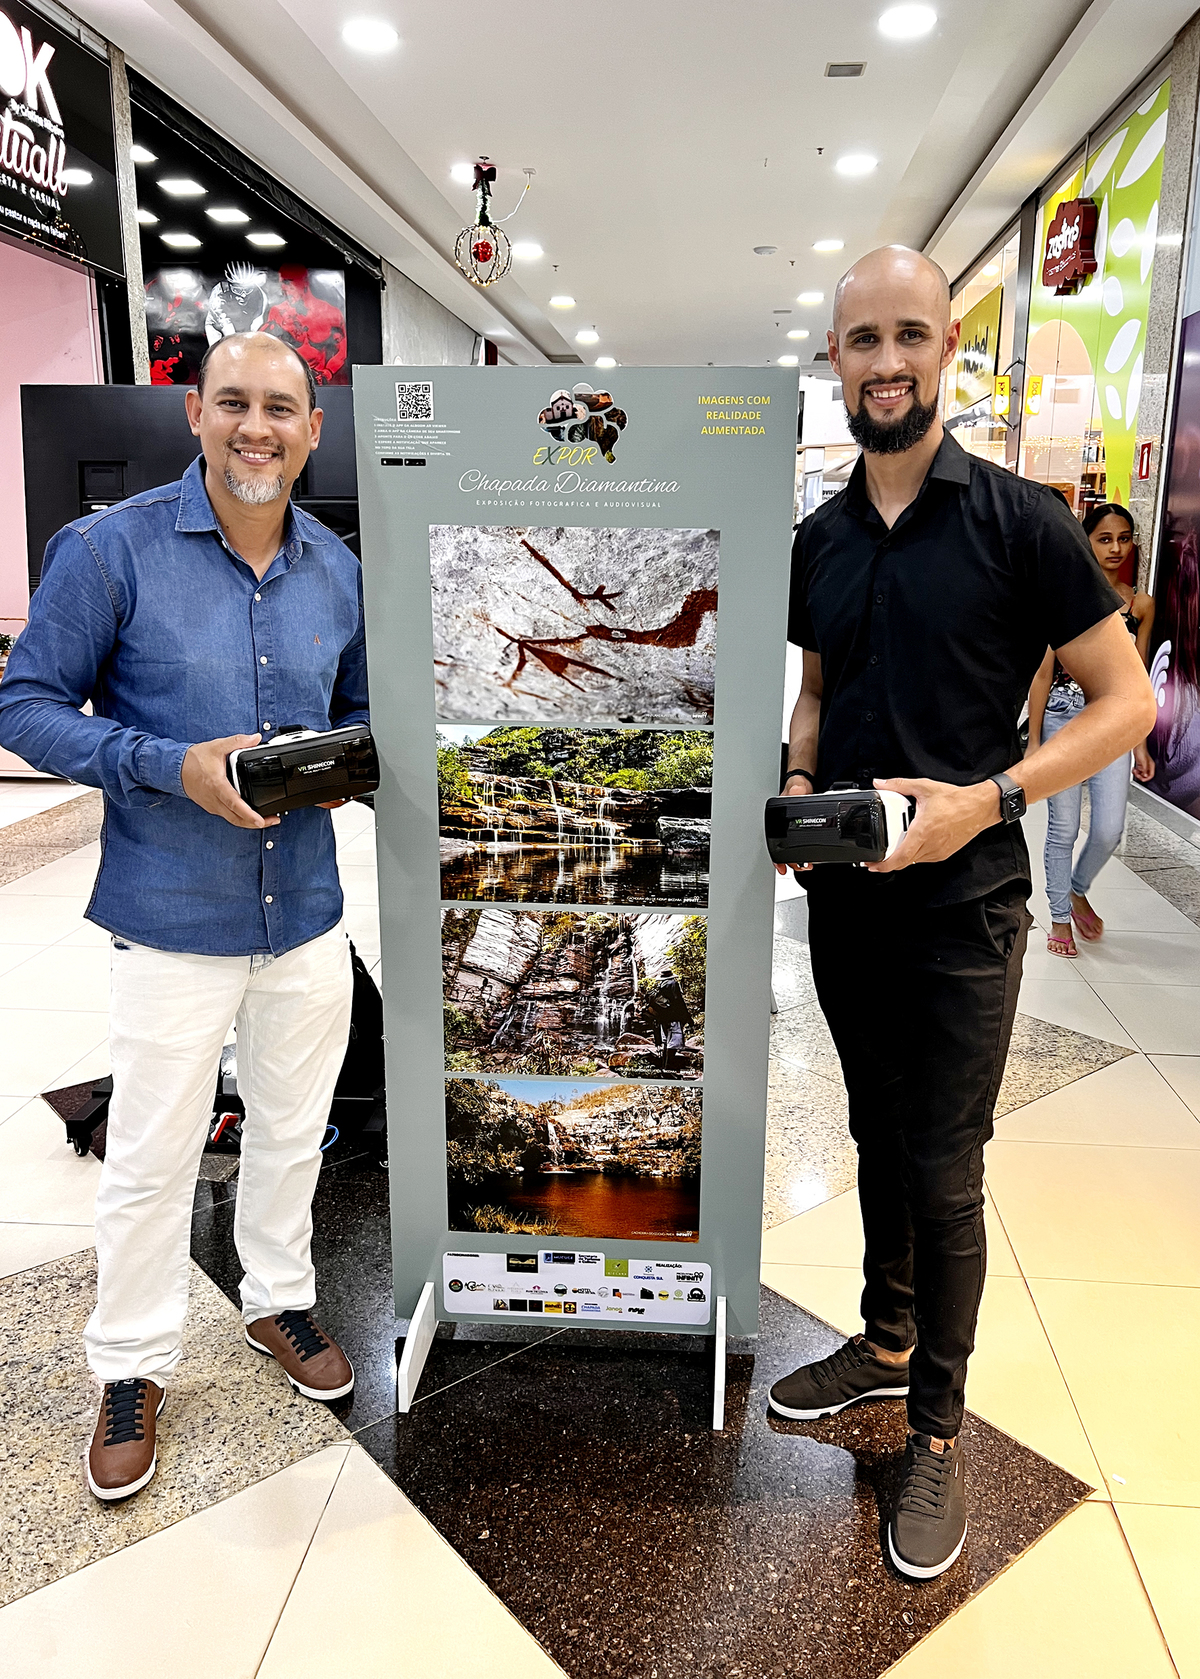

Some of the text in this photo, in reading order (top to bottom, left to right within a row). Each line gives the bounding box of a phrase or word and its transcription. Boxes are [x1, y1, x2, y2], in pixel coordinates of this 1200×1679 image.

[698, 396, 771, 405] IMAGENS COM
[706, 411, 762, 420] REALIDADE
[700, 426, 766, 435] AUMENTADA
[532, 446, 598, 466] EXPOR
[458, 469, 681, 496] Chapada Diamantina
[476, 499, 526, 507] EXPOSIÇÃO
